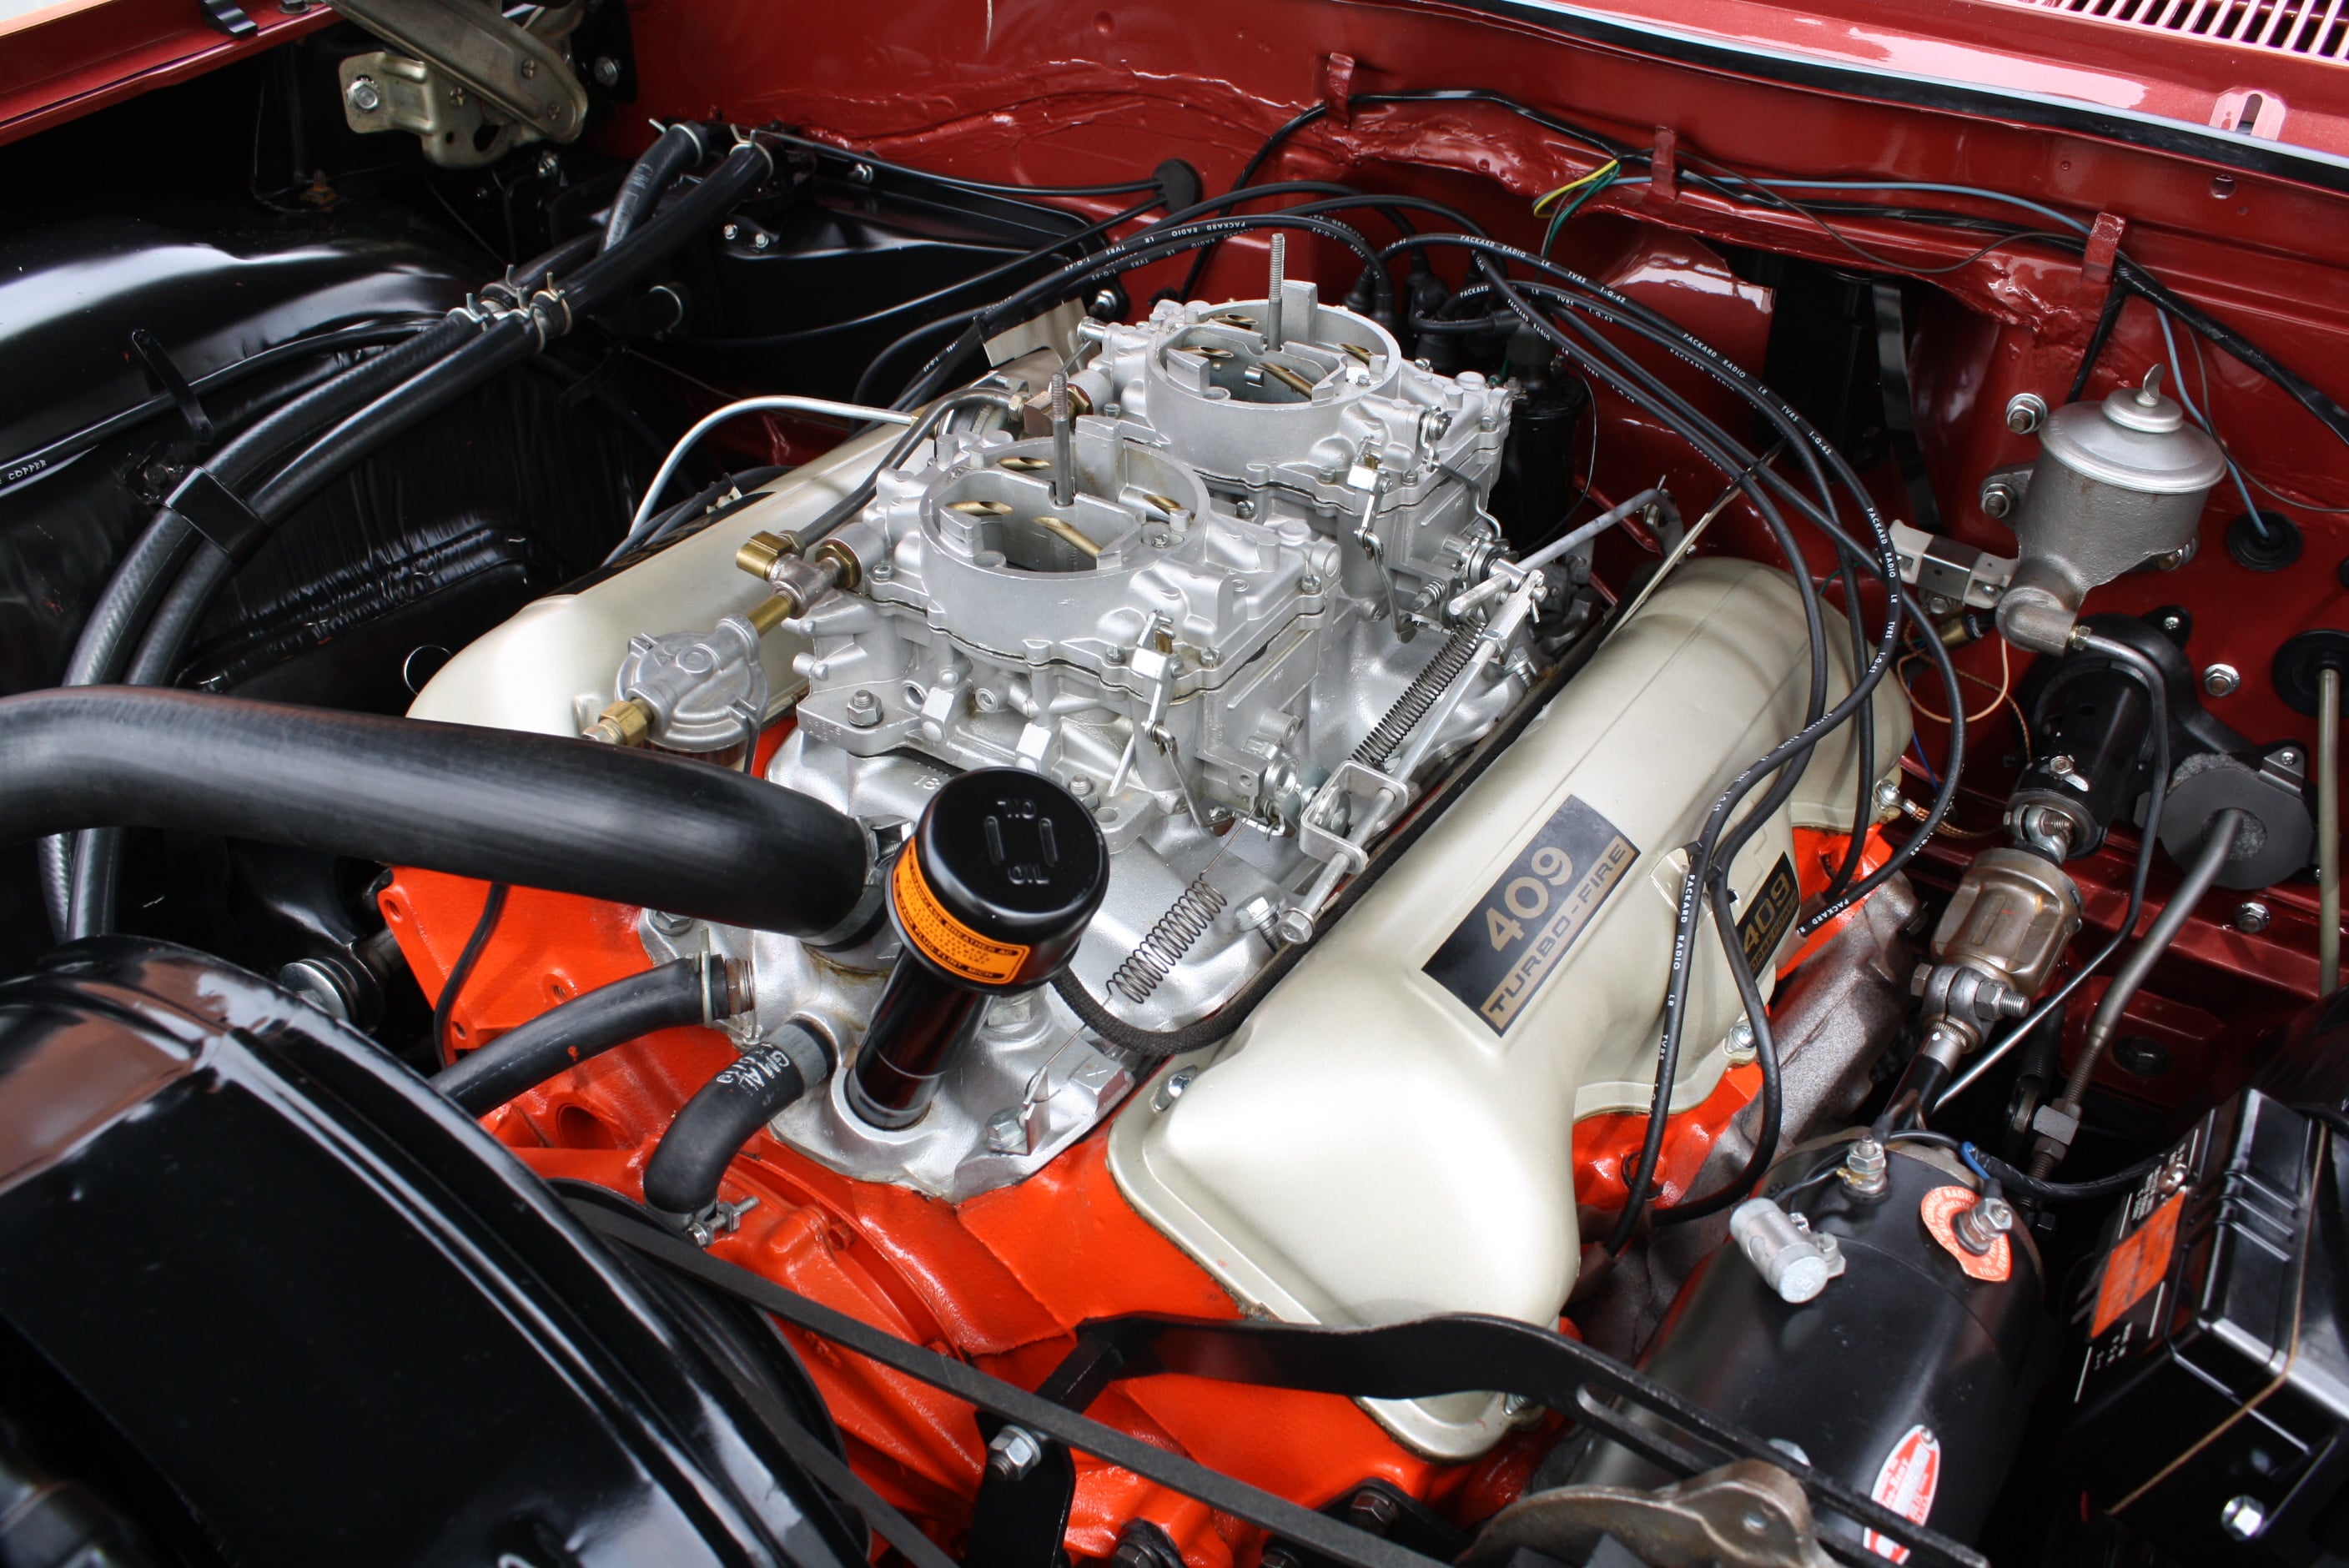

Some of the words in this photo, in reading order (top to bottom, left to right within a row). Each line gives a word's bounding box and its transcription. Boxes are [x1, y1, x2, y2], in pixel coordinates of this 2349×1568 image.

[1171, 227, 1198, 238] RADIO
[1206, 221, 1245, 231] PACKARD
[1106, 244, 1126, 255] TVRS
[1191, 238, 1215, 248] RADIO
[1130, 258, 1149, 268] TVRS
[1460, 235, 1496, 248] PACKARD
[1501, 245, 1527, 258] RADIO
[1541, 259, 1551, 268] LR
[1567, 271, 1587, 284] TVRS
[1460, 284, 1489, 299] PACKARD
[1557, 295, 1574, 306] TVRS
[1507, 299, 1529, 322] PACKARD
[1533, 323, 1551, 341] RADIO
[1683, 333, 1718, 358] PACKARD
[1722, 359, 1746, 379] RADIO
[1758, 385, 1768, 396] LR
[1782, 405, 1799, 422] TVRS
[8, 460, 47, 480] COPPER
[1867, 507, 1888, 545] PACKARD
[1884, 552, 1896, 578] RADIO
[1890, 594, 1898, 604] LR
[1885, 621, 1895, 639] TVRS
[1008, 864, 1049, 884] OIL
[1486, 847, 1572, 952] 409
[1680, 874, 1696, 923] PACKARD
[1743, 872, 1791, 955] 409
[1811, 898, 1849, 925] PACKARD
[1488, 844, 1627, 1013] TURBO-FIRE
[1673, 934, 1685, 970] RADIO
[1667, 994, 1675, 1007] LR
[1944, 1189, 1974, 1204] RADIO
